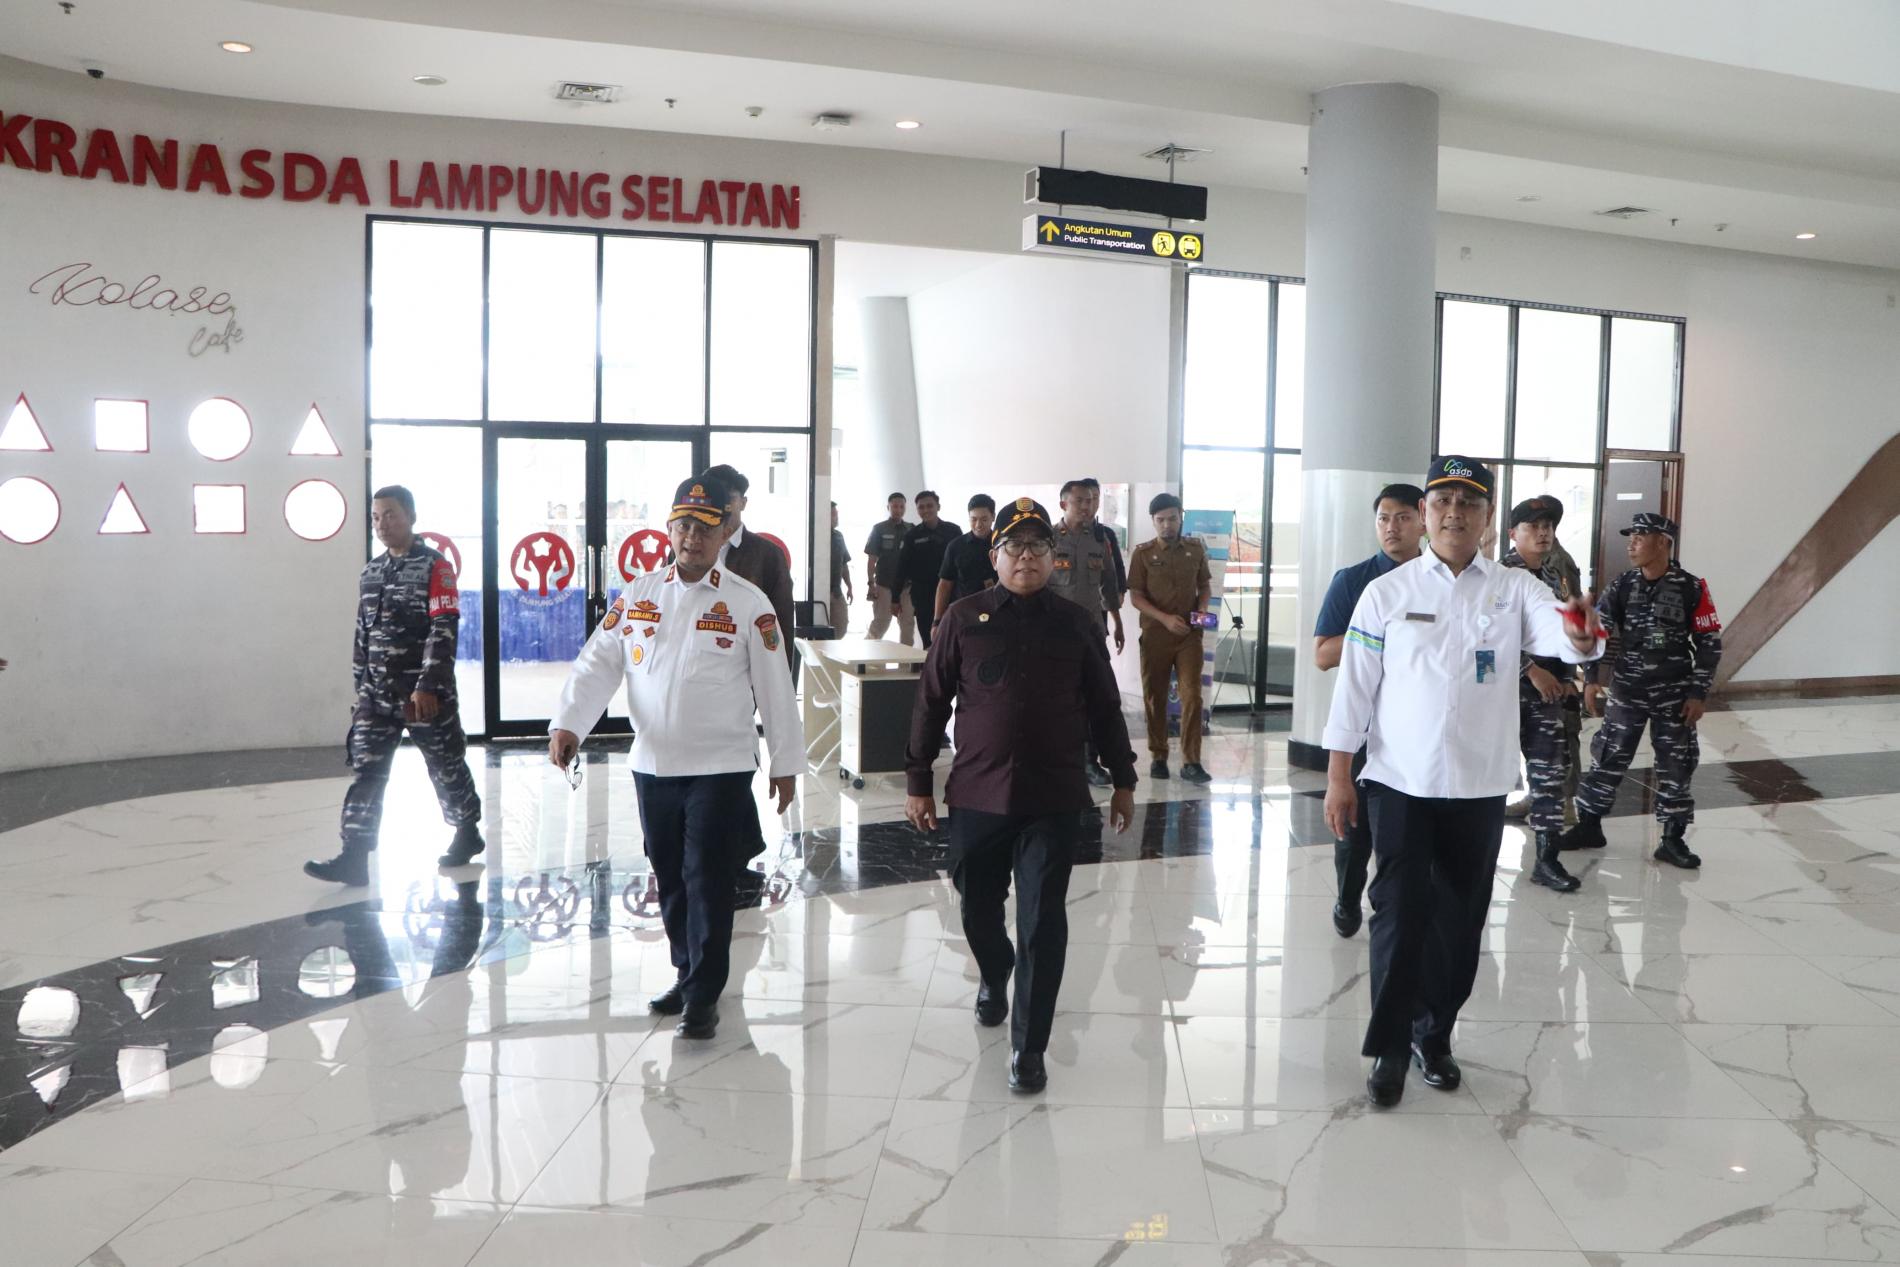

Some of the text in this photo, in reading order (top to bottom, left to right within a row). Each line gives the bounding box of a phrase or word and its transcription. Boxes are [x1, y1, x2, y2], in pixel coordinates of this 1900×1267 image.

[0, 110, 800, 230] KRANASDA LAMPUNG SELATAN
[1064, 223, 1132, 239] Angkutan Umum
[1064, 234, 1146, 250] Public Transportation
[29, 262, 234, 315] Kolase
[1449, 468, 1473, 478] asdp
[698, 621, 734, 632] DISHUB
